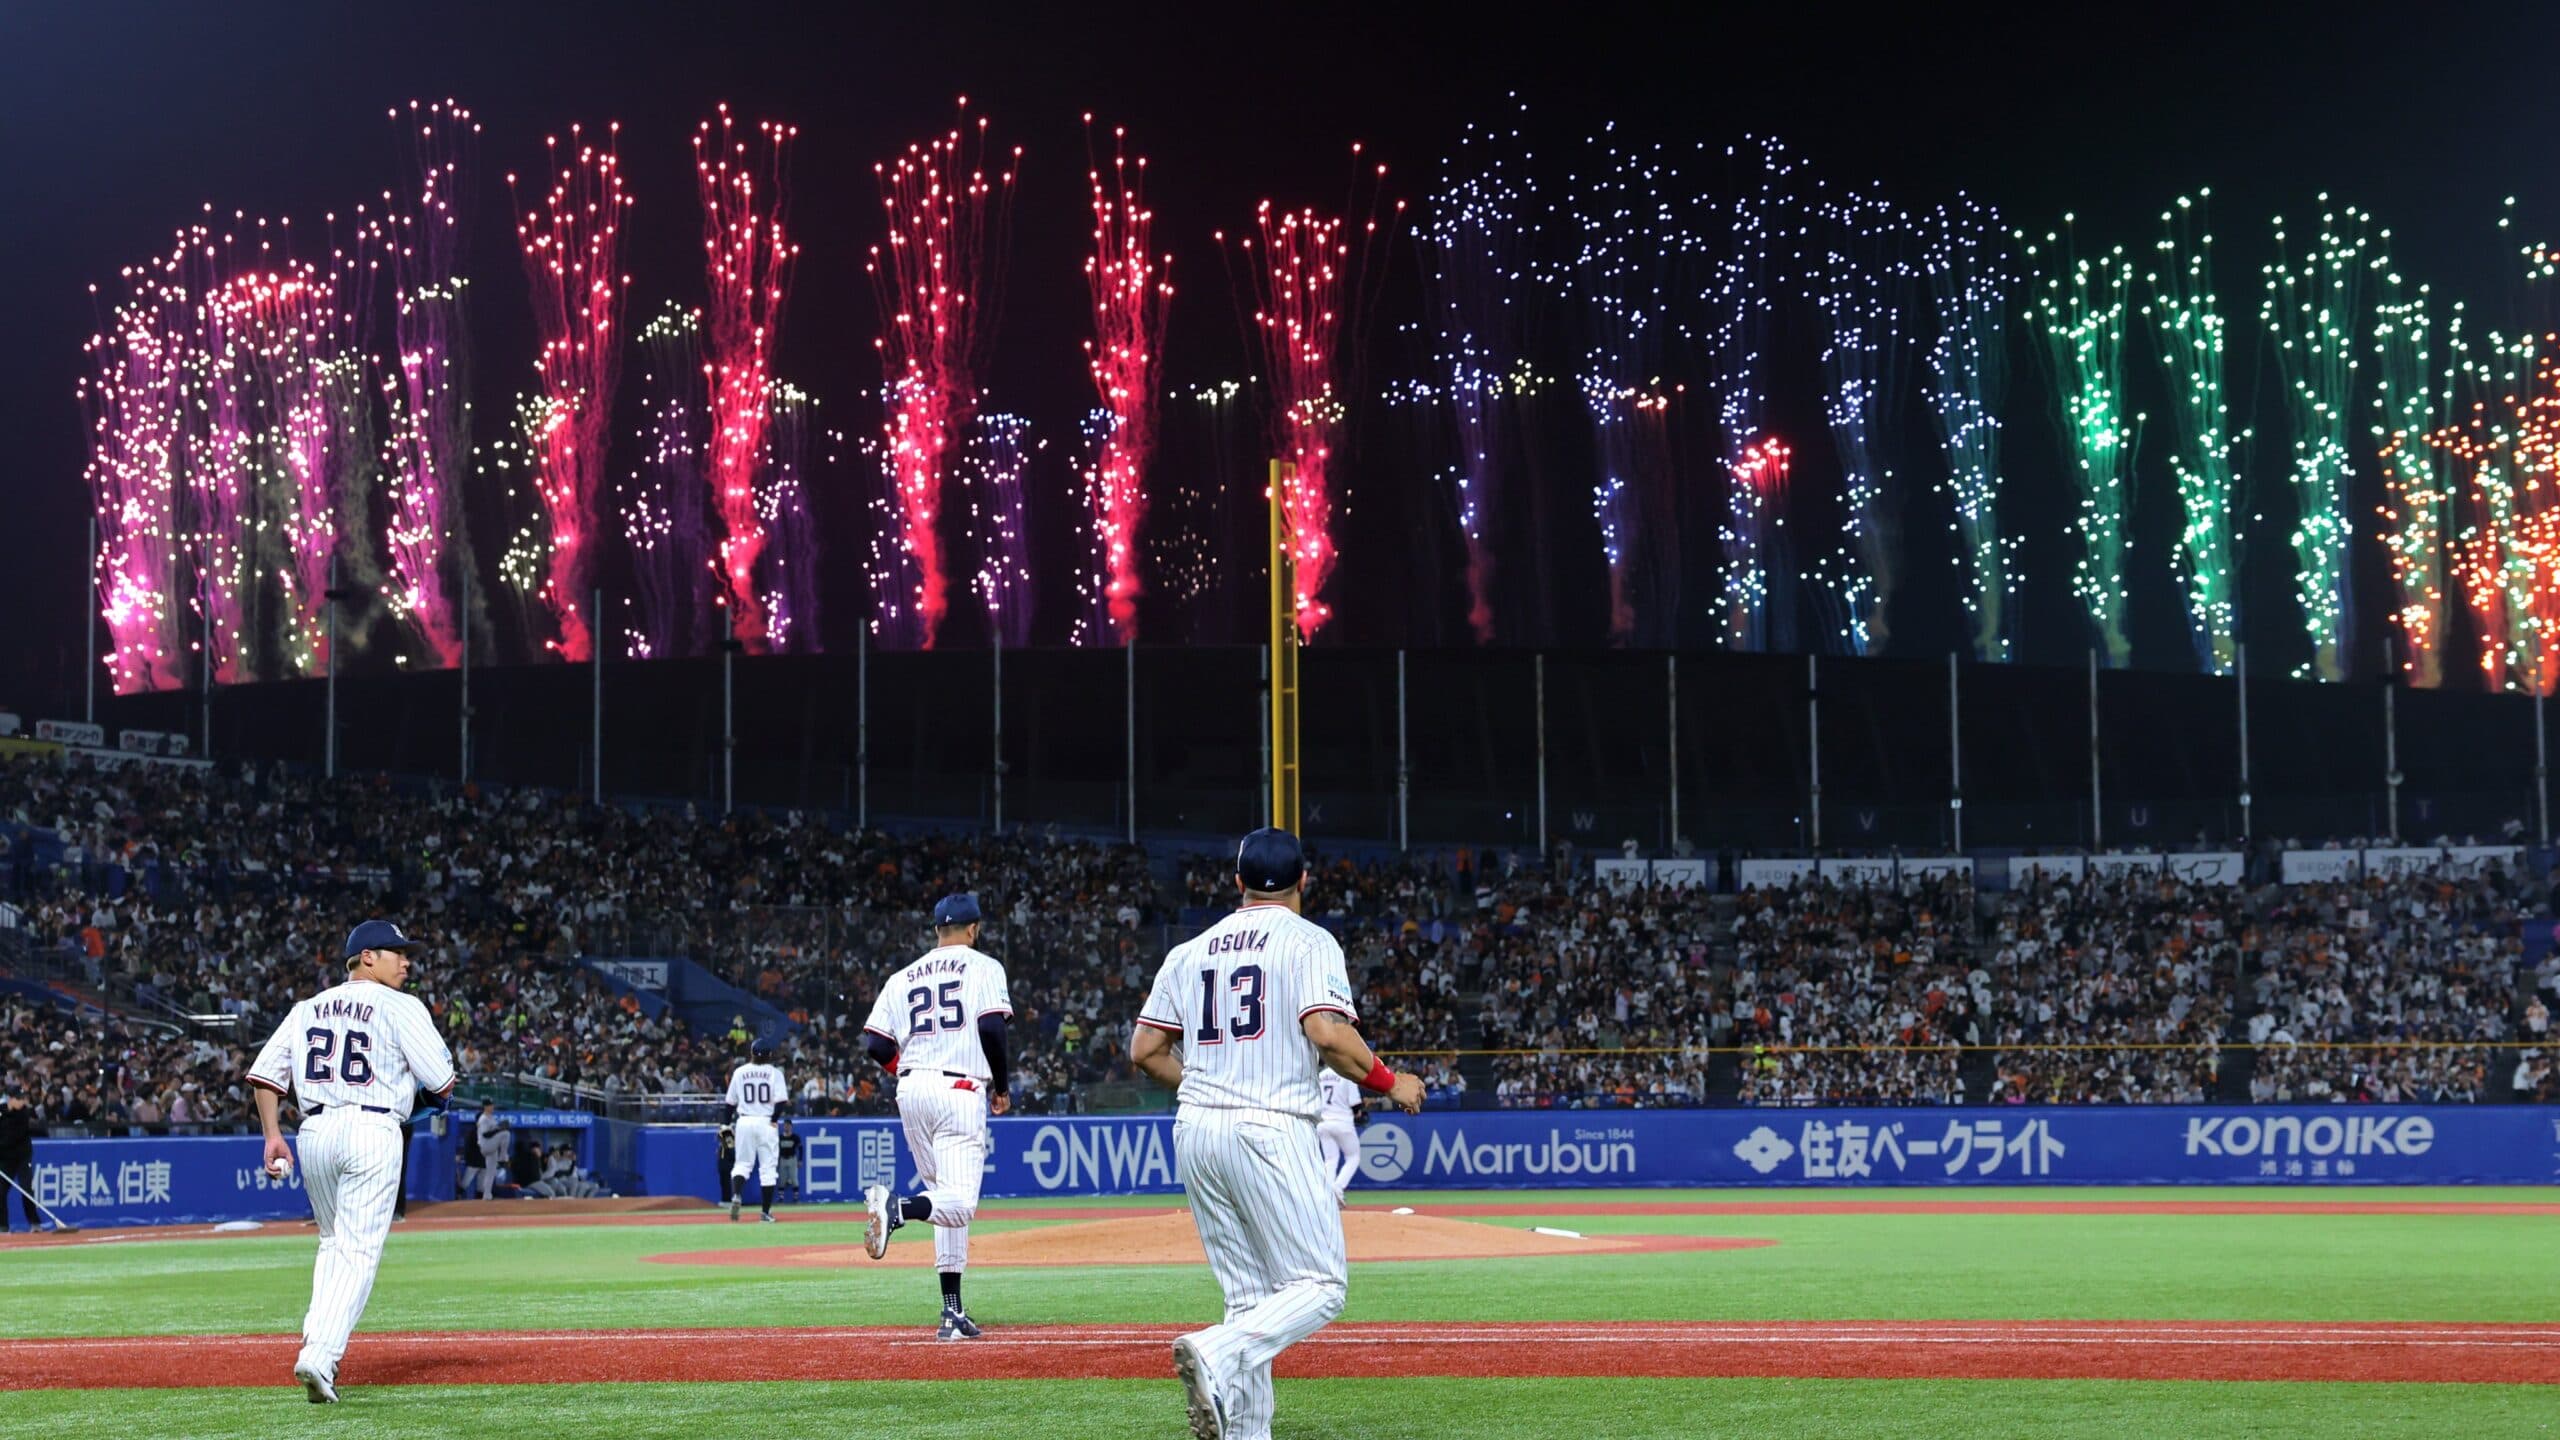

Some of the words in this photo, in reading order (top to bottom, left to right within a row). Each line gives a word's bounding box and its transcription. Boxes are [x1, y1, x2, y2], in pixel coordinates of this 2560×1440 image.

[1573, 812, 1594, 830] W
[1859, 812, 1875, 830] V
[2131, 808, 2147, 825] U
[1208, 930, 1270, 956] OSUNA
[906, 958, 967, 983] SANTANA
[314, 999, 374, 1022] YAMANO
[908, 980, 966, 1035] 25
[1198, 963, 1266, 1045] 13
[304, 1026, 375, 1086] 26
[743, 1082, 771, 1104] 00
[1575, 1128, 1605, 1140] Since
[1607, 1128, 1634, 1140] 1844
[1423, 1128, 1636, 1175] Marubun
[1799, 1119, 2066, 1178] 住友ベークライト
[32, 1161, 87, 1207] 伯東
[117, 1160, 171, 1204] 伯東
